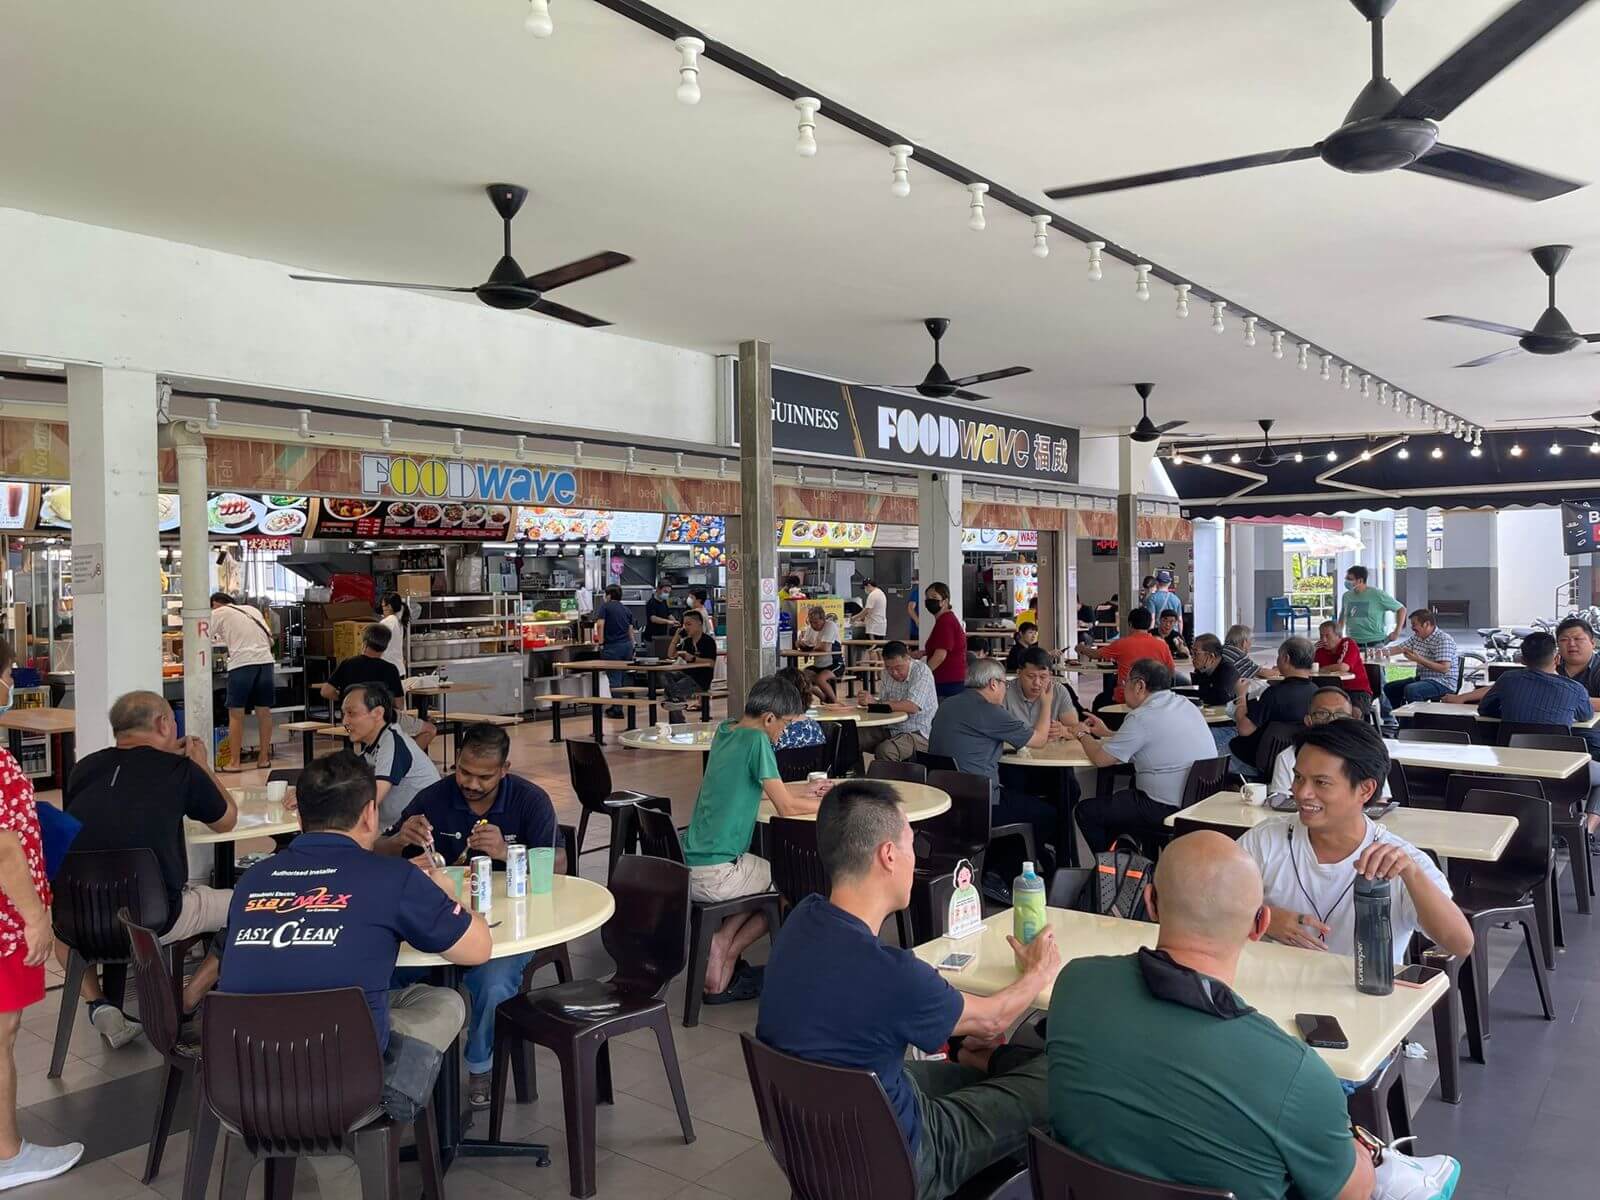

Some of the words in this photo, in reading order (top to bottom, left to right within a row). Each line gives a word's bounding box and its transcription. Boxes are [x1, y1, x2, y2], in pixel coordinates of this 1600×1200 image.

[1033, 433, 1068, 474] 福威
[198, 621, 209, 638] R
[199, 650, 205, 666] 1
[235, 927, 273, 942] EASY
[273, 920, 340, 948] CLEAN
